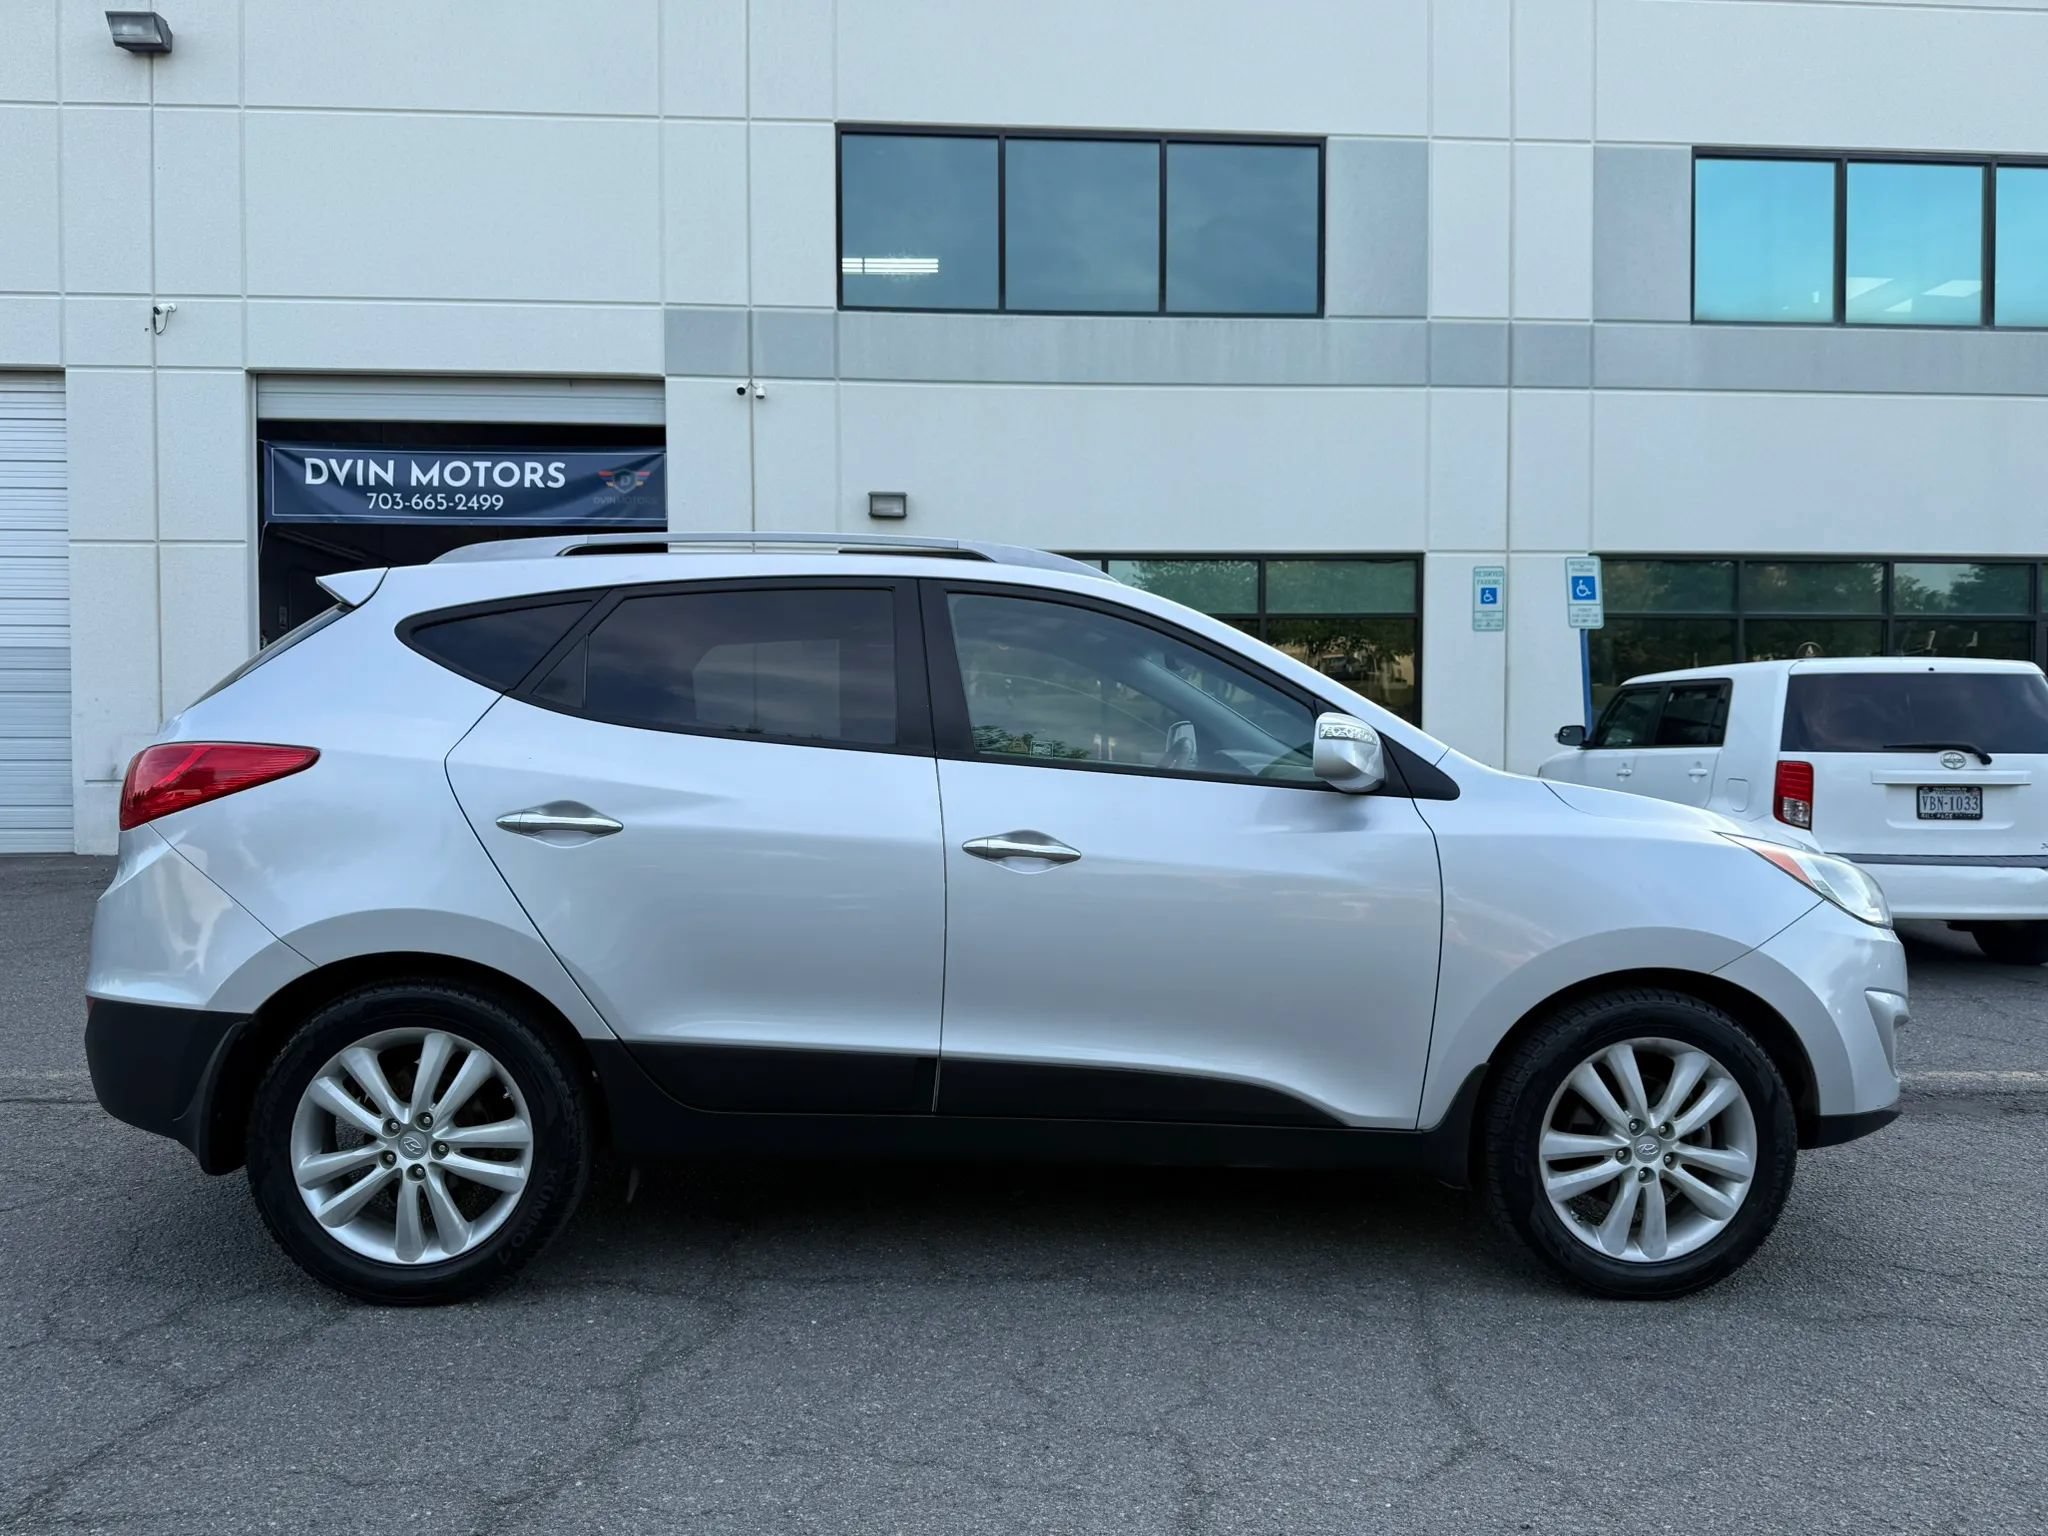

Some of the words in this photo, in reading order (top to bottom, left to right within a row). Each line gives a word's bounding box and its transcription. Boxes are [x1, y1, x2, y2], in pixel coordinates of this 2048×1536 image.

[304, 457, 395, 487] DVIN
[410, 459, 566, 489] MOTORS
[366, 493, 504, 511] 703-665-2499
[1921, 795, 1979, 811] VBN-1033
